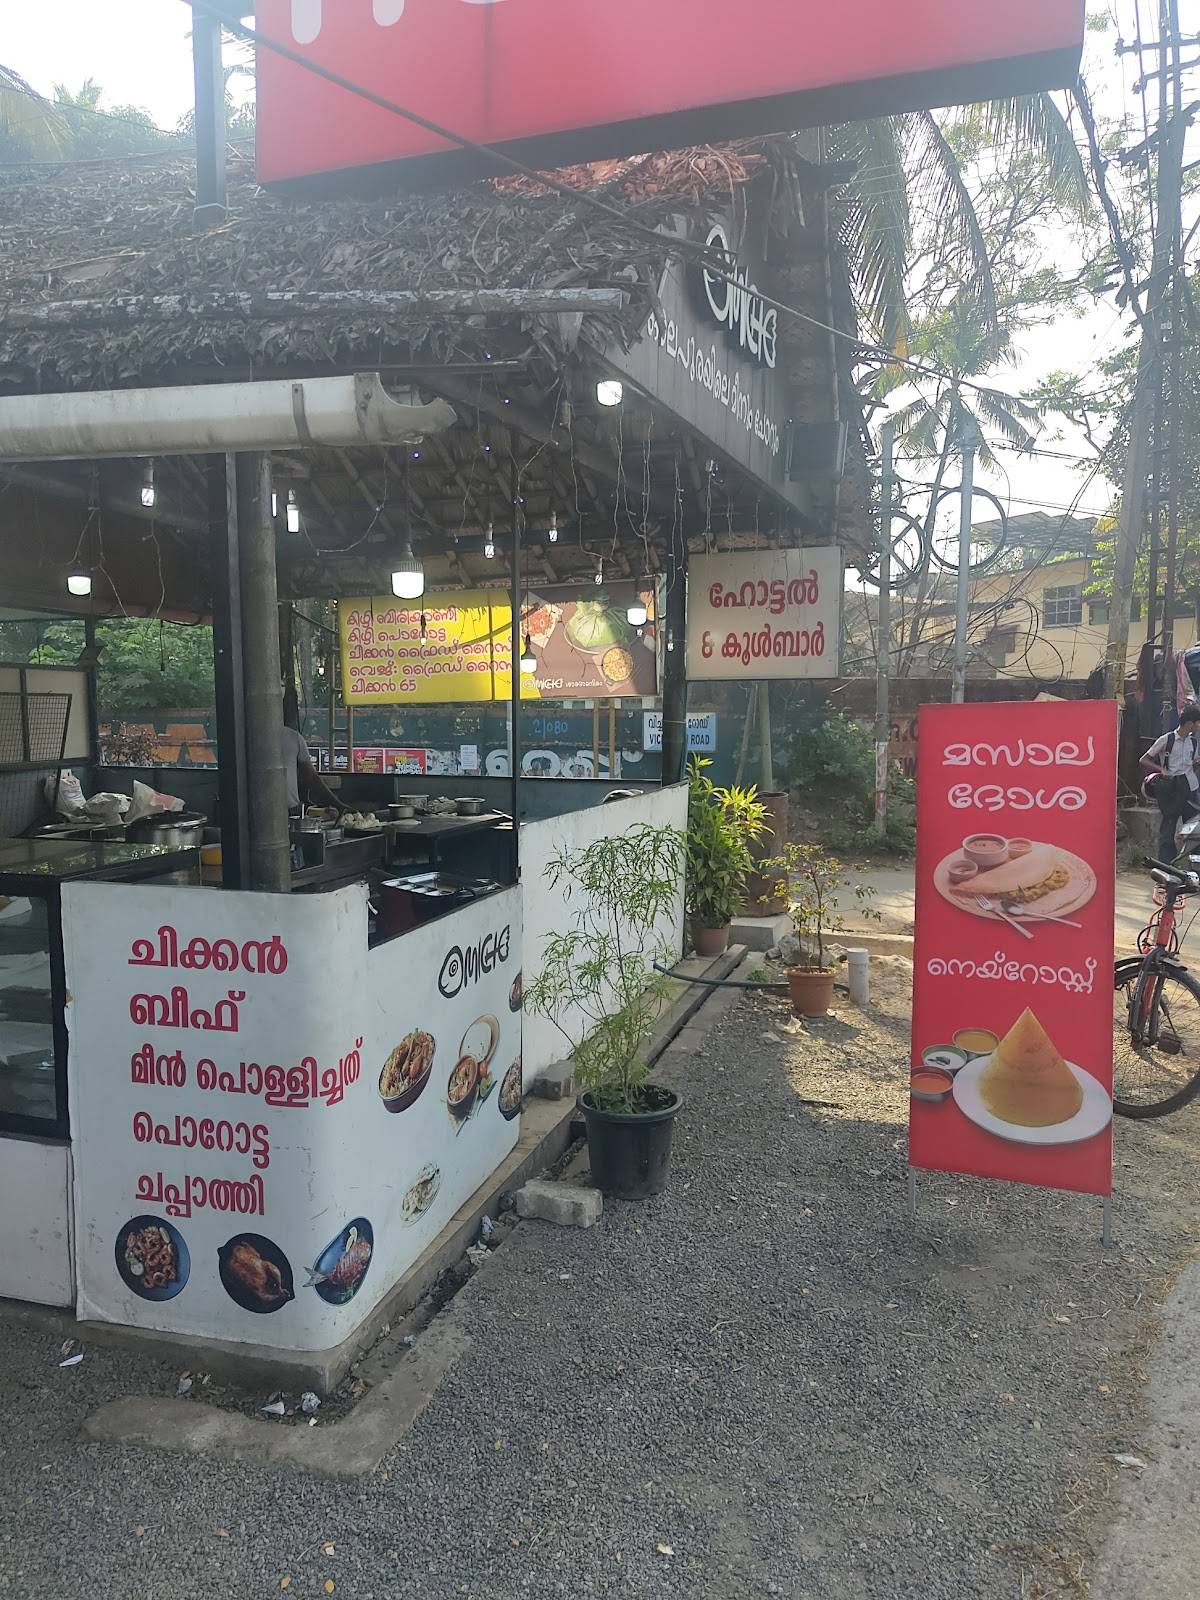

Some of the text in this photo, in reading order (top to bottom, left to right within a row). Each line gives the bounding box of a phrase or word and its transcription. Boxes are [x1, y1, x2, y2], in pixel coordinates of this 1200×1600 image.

[709, 569, 819, 614] ഹോട്ടൽ
[349, 644, 394, 660] ചിക്കൻ
[351, 678, 416, 694] ചിക്കൻ 65
[690, 734, 710, 745] ROAD
[942, 736, 1095, 767] മസാല
[948, 783, 1087, 812] ദോശ
[128, 925, 288, 975] ചിക്കൻ
[129, 986, 246, 1032] ബീഫ്
[131, 1036, 363, 1108] മീൻ പൊള്ളിച്ചത്
[133, 1111, 270, 1169] പൊറോട്ട
[136, 1172, 265, 1218] ചപ്പാത്തി
